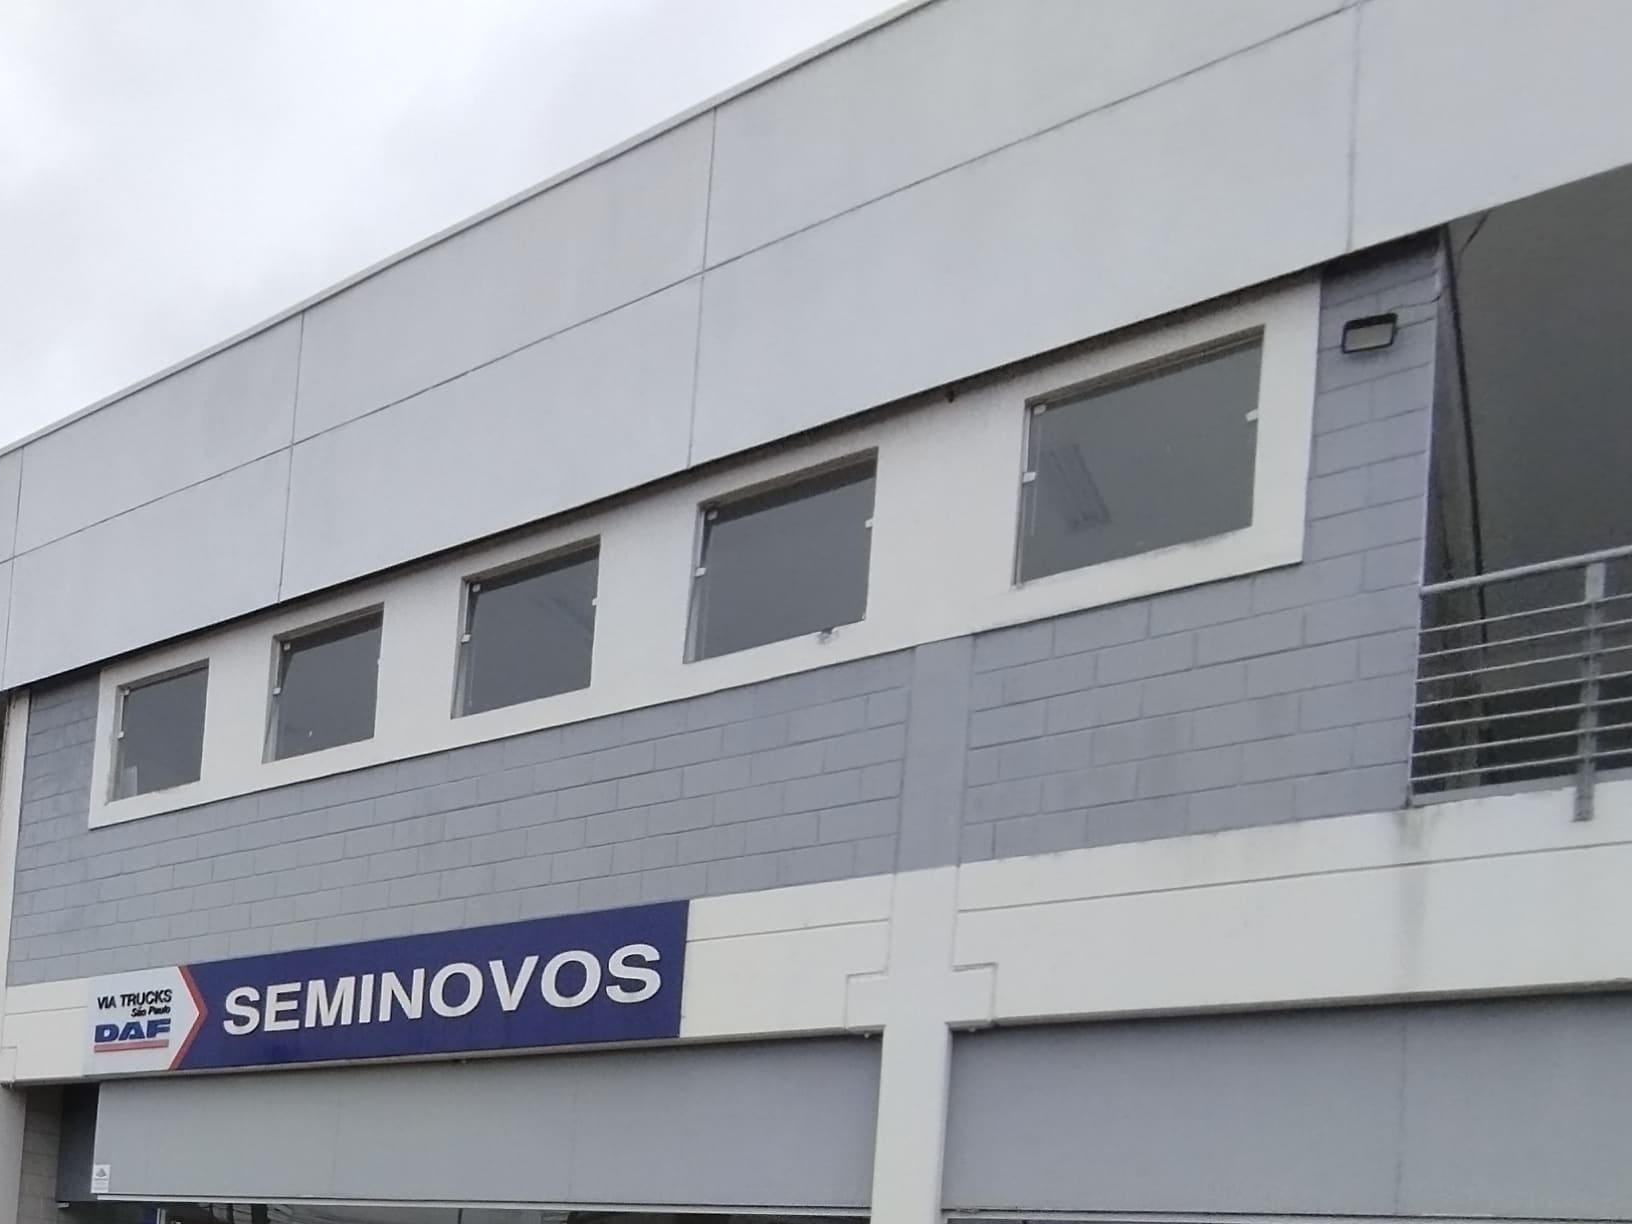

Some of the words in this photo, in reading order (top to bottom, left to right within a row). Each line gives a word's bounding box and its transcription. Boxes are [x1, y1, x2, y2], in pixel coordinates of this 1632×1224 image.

[97, 995, 117, 1009] VIA
[120, 989, 172, 1007] TRUCKS
[223, 943, 662, 1036] SEMINOVOS
[95, 1018, 171, 1043] DAF
